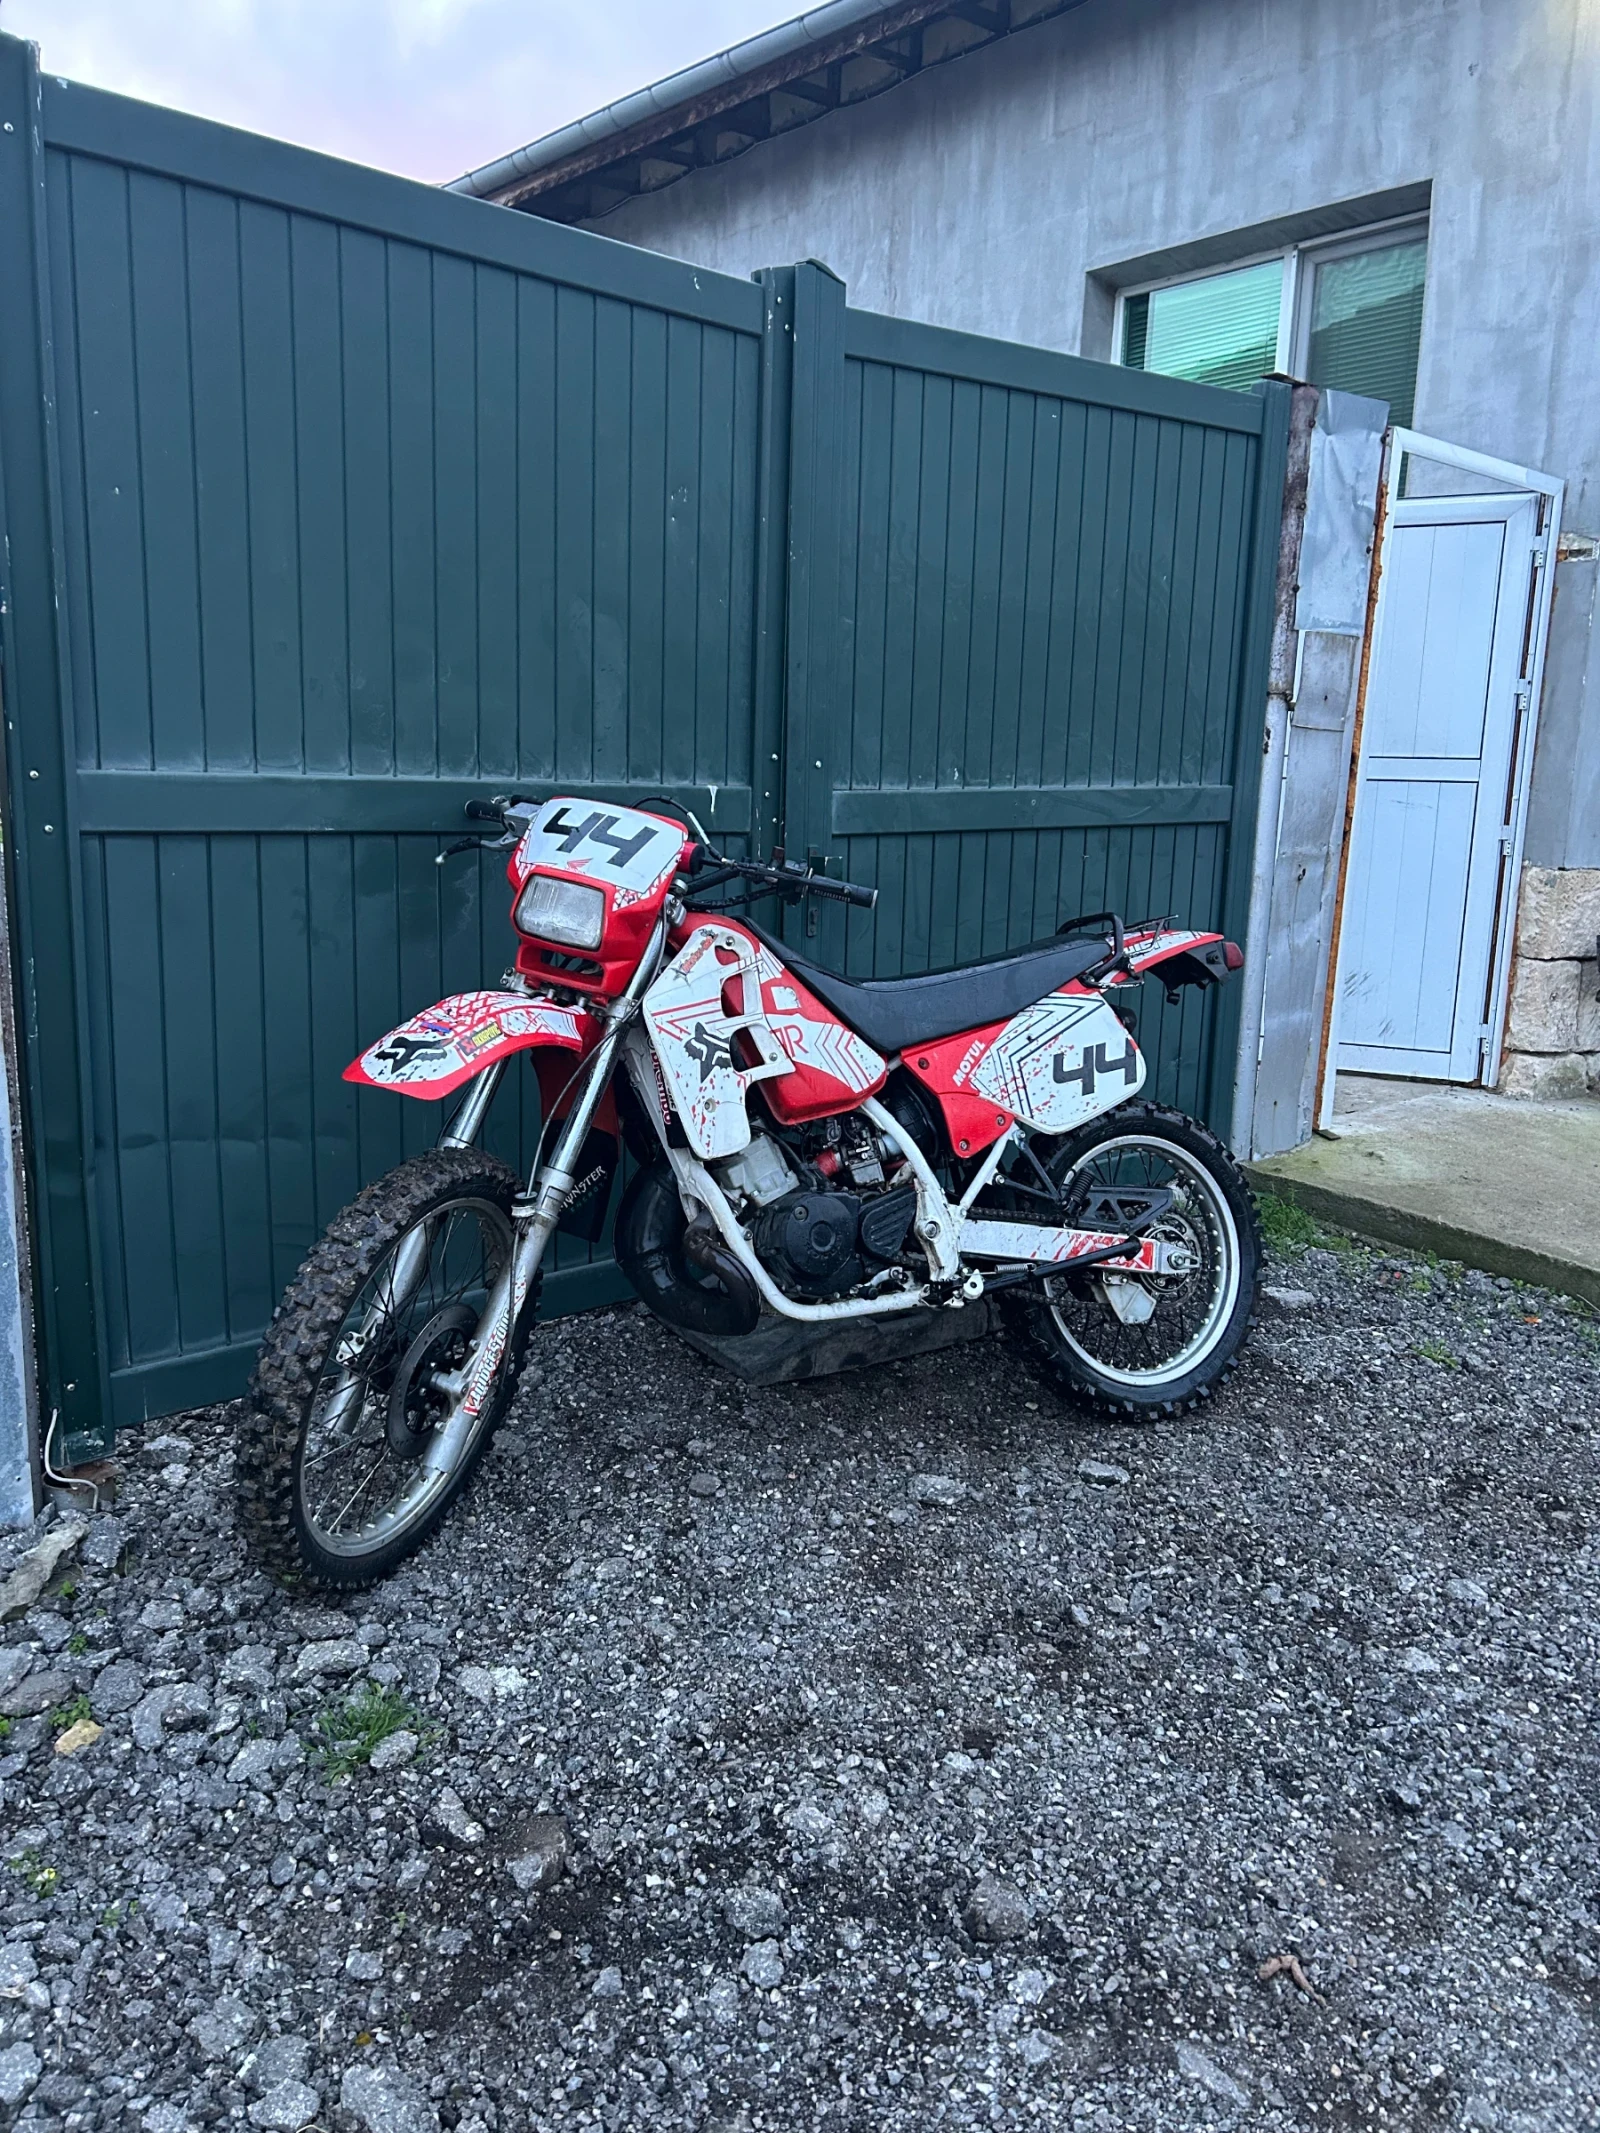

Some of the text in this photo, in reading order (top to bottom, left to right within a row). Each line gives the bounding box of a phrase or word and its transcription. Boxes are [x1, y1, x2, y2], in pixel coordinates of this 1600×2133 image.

[543, 807, 659, 868] 44
[952, 1039, 986, 1087] MOTUL
[1053, 1037, 1137, 1096] 44
